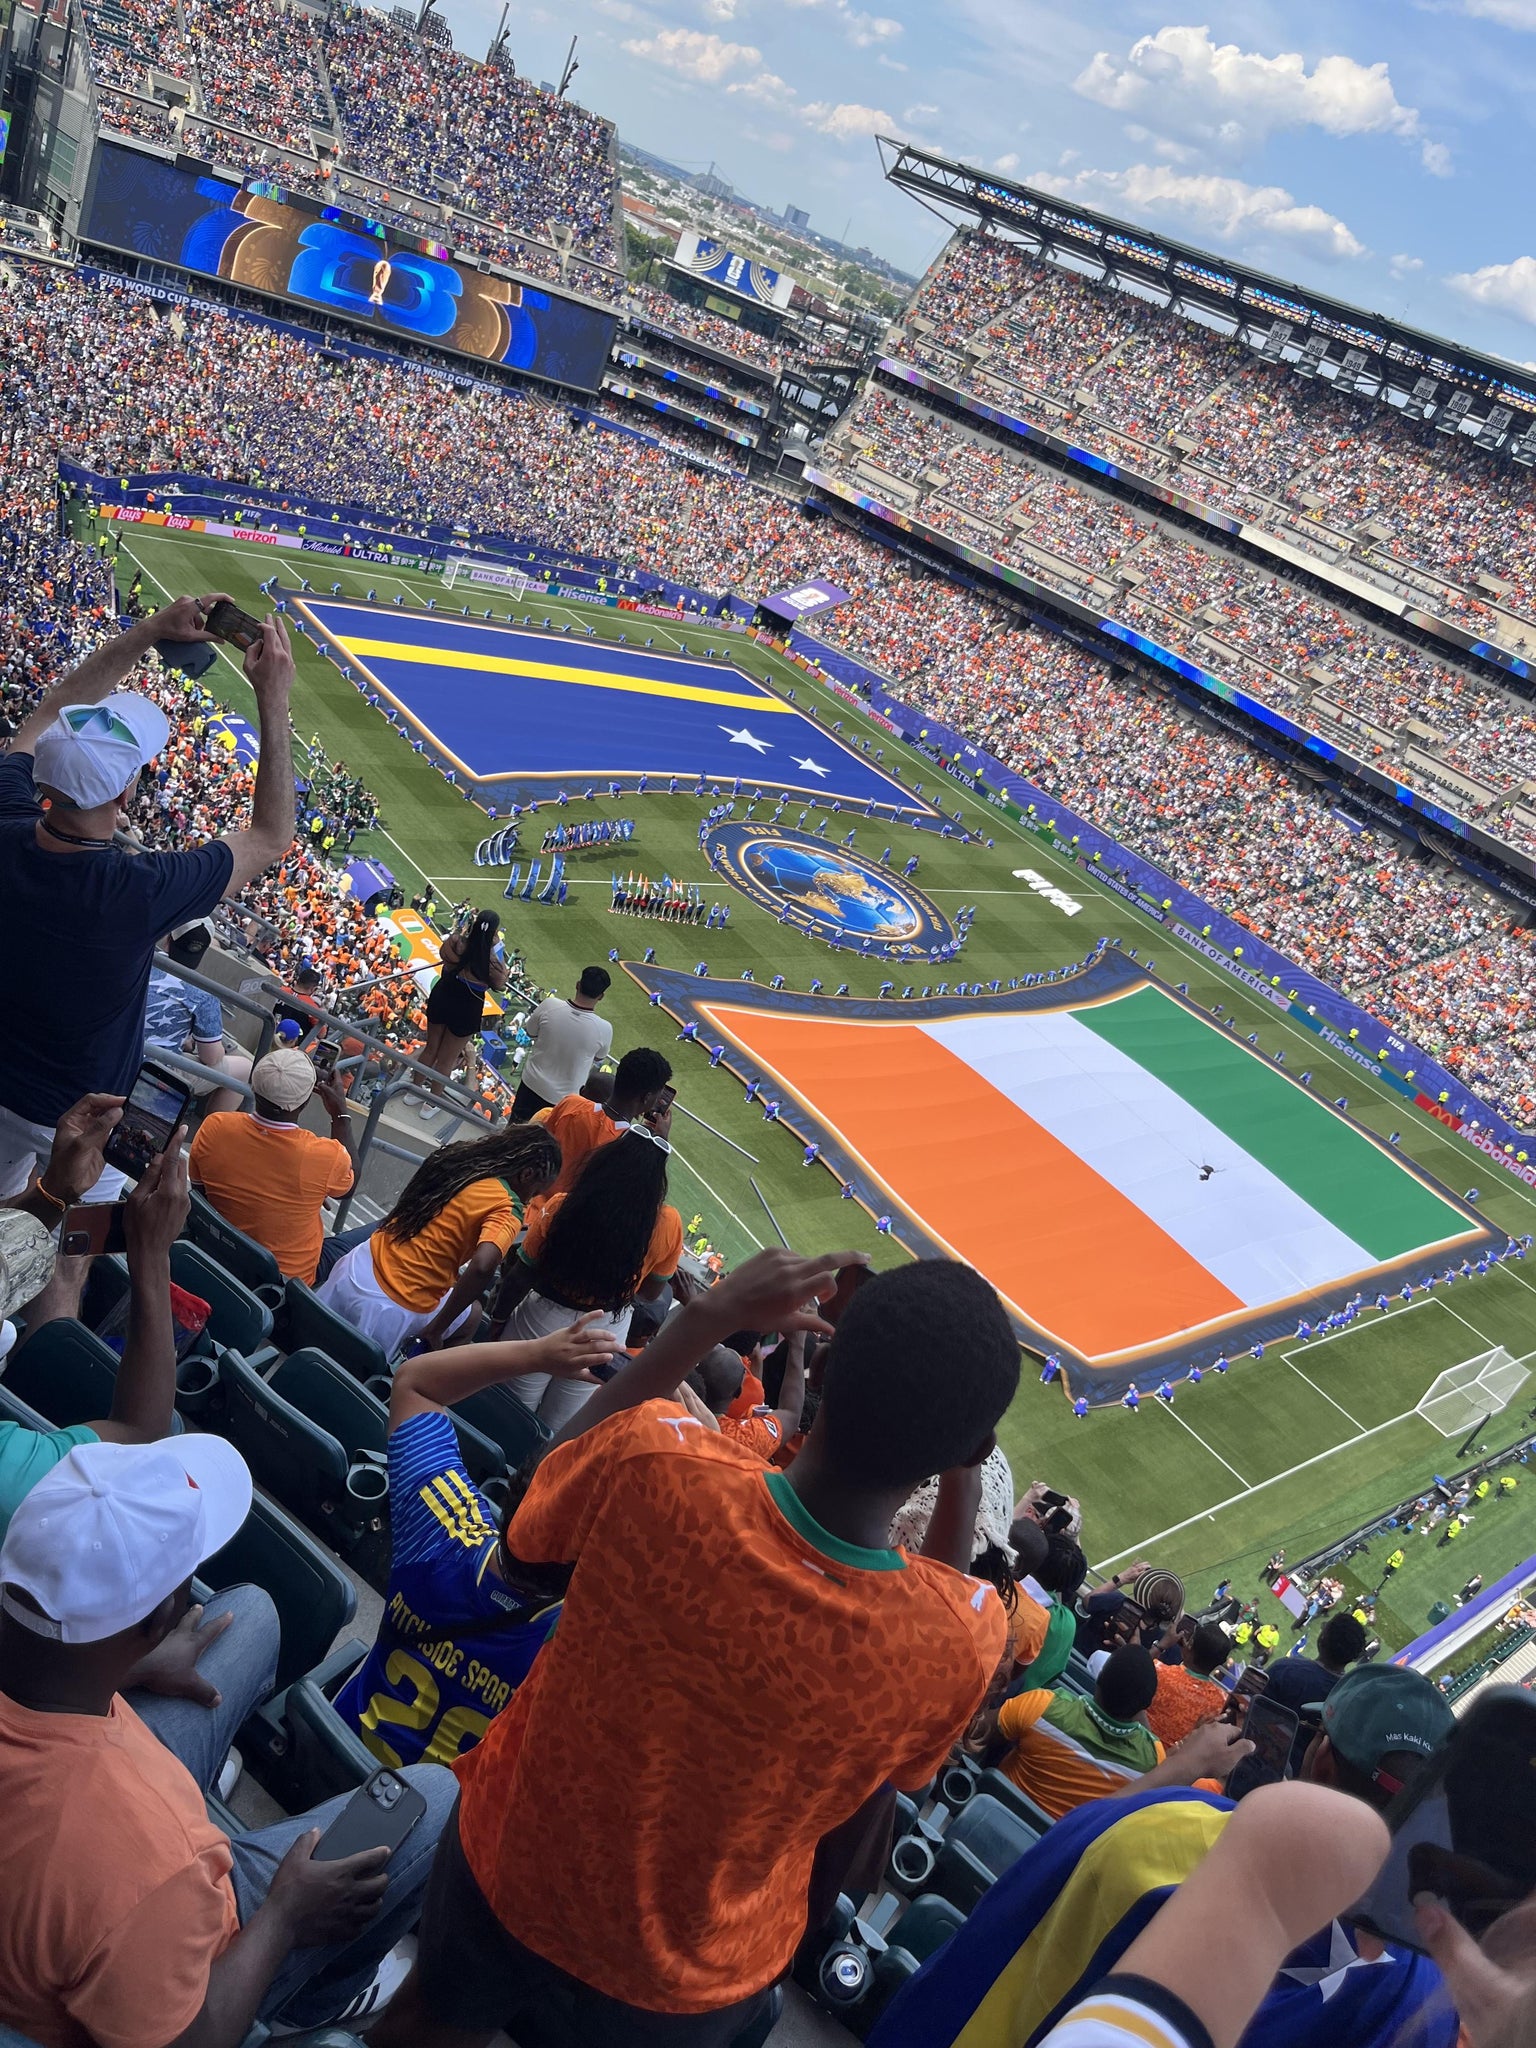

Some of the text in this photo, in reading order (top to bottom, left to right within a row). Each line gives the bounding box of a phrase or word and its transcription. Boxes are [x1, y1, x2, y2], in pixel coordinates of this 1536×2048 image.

[99, 273, 229, 317] FIFA WORLD CUP 2026
[402, 360, 502, 396] FIFA WORLD CUP 2026
[658, 441, 732, 476] PHILADELPHIA
[232, 529, 277, 545] verizon
[303, 540, 389, 563] Michelob ULTRA
[896, 544, 950, 576] PHILADELPHIA
[472, 572, 494, 582] BANK
[494, 576, 505, 585] OF
[506, 577, 538, 590] AMERICA
[557, 586, 608, 606] Hisense
[635, 603, 683, 621] McDonald's
[833, 685, 858, 707] verizon
[868, 709, 894, 733] verizon
[1199, 705, 1254, 741] PHILADELPHIA
[964, 745, 978, 758] FIFA
[946, 763, 975, 790] ULTRA
[1352, 795, 1372, 810] WORLD
[1371, 806, 1383, 816] CUP
[1382, 812, 1403, 828] 2026
[741, 826, 782, 837] FIFA
[747, 885, 772, 905] CUP
[1087, 863, 1164, 921] UNITED STATES OF AMERICA
[1177, 927, 1273, 999] BANK OF AMERICA
[1318, 1025, 1382, 1077] Hisense
[1386, 1035, 1406, 1053] FIFA
[1456, 1123, 1536, 1189] McDonald
[461, 1660, 517, 1713] SPOR
[1386, 1733, 1402, 1743] Mas
[1403, 1732, 1422, 1746] Kaki
